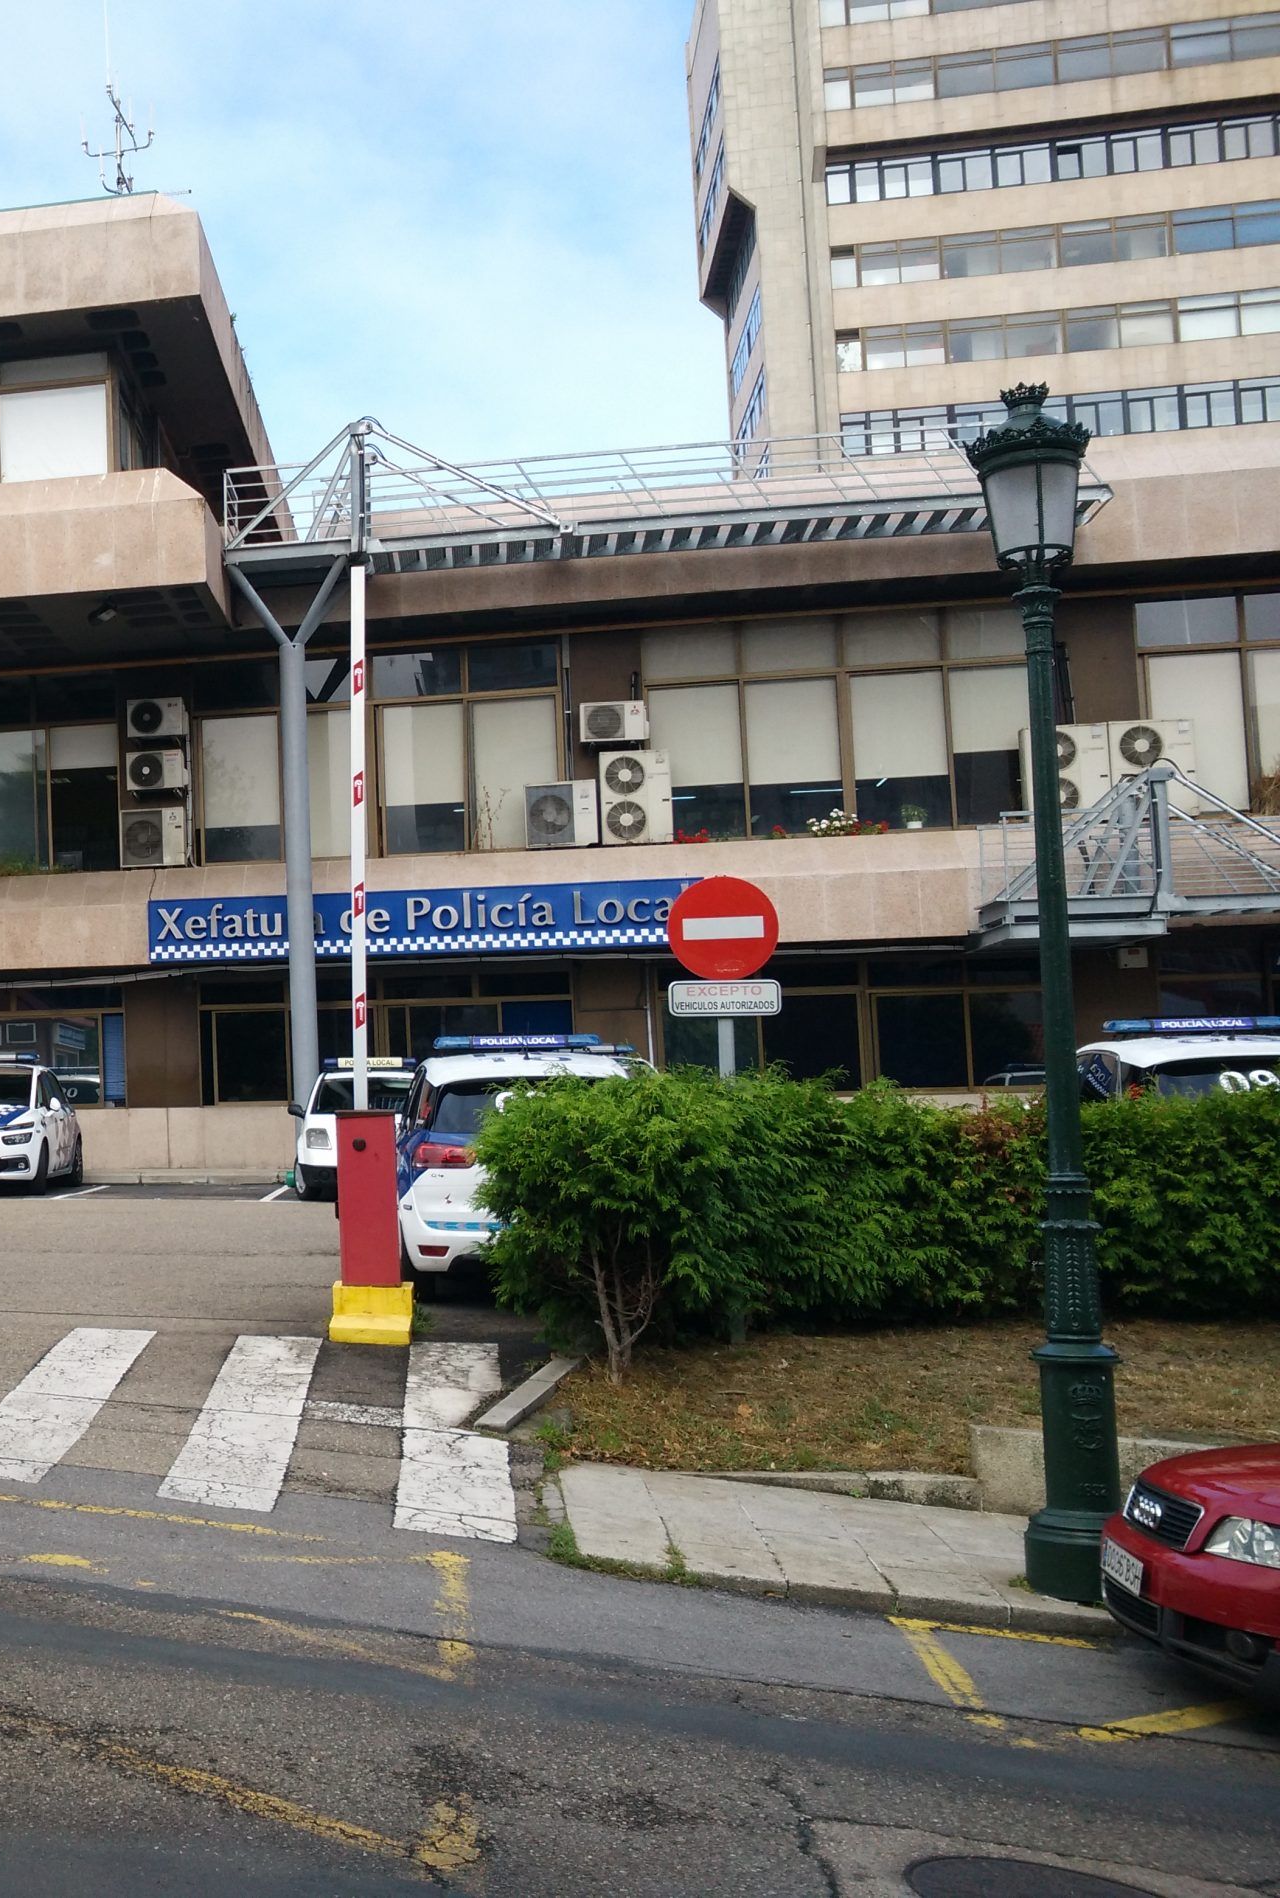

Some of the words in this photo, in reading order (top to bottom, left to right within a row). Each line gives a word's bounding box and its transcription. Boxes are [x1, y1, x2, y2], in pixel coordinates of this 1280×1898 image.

[157, 905, 325, 939] Xefatu
[407, 892, 554, 931] Policía
[573, 883, 689, 925] Loca
[686, 985, 762, 996] EXCEPTO
[675, 1001, 718, 1011] VEHICULOS
[720, 1000, 775, 1010] AUTORIZADOS
[1212, 1019, 1246, 1027] LOCAL
[527, 1036, 558, 1045] LOCAL
